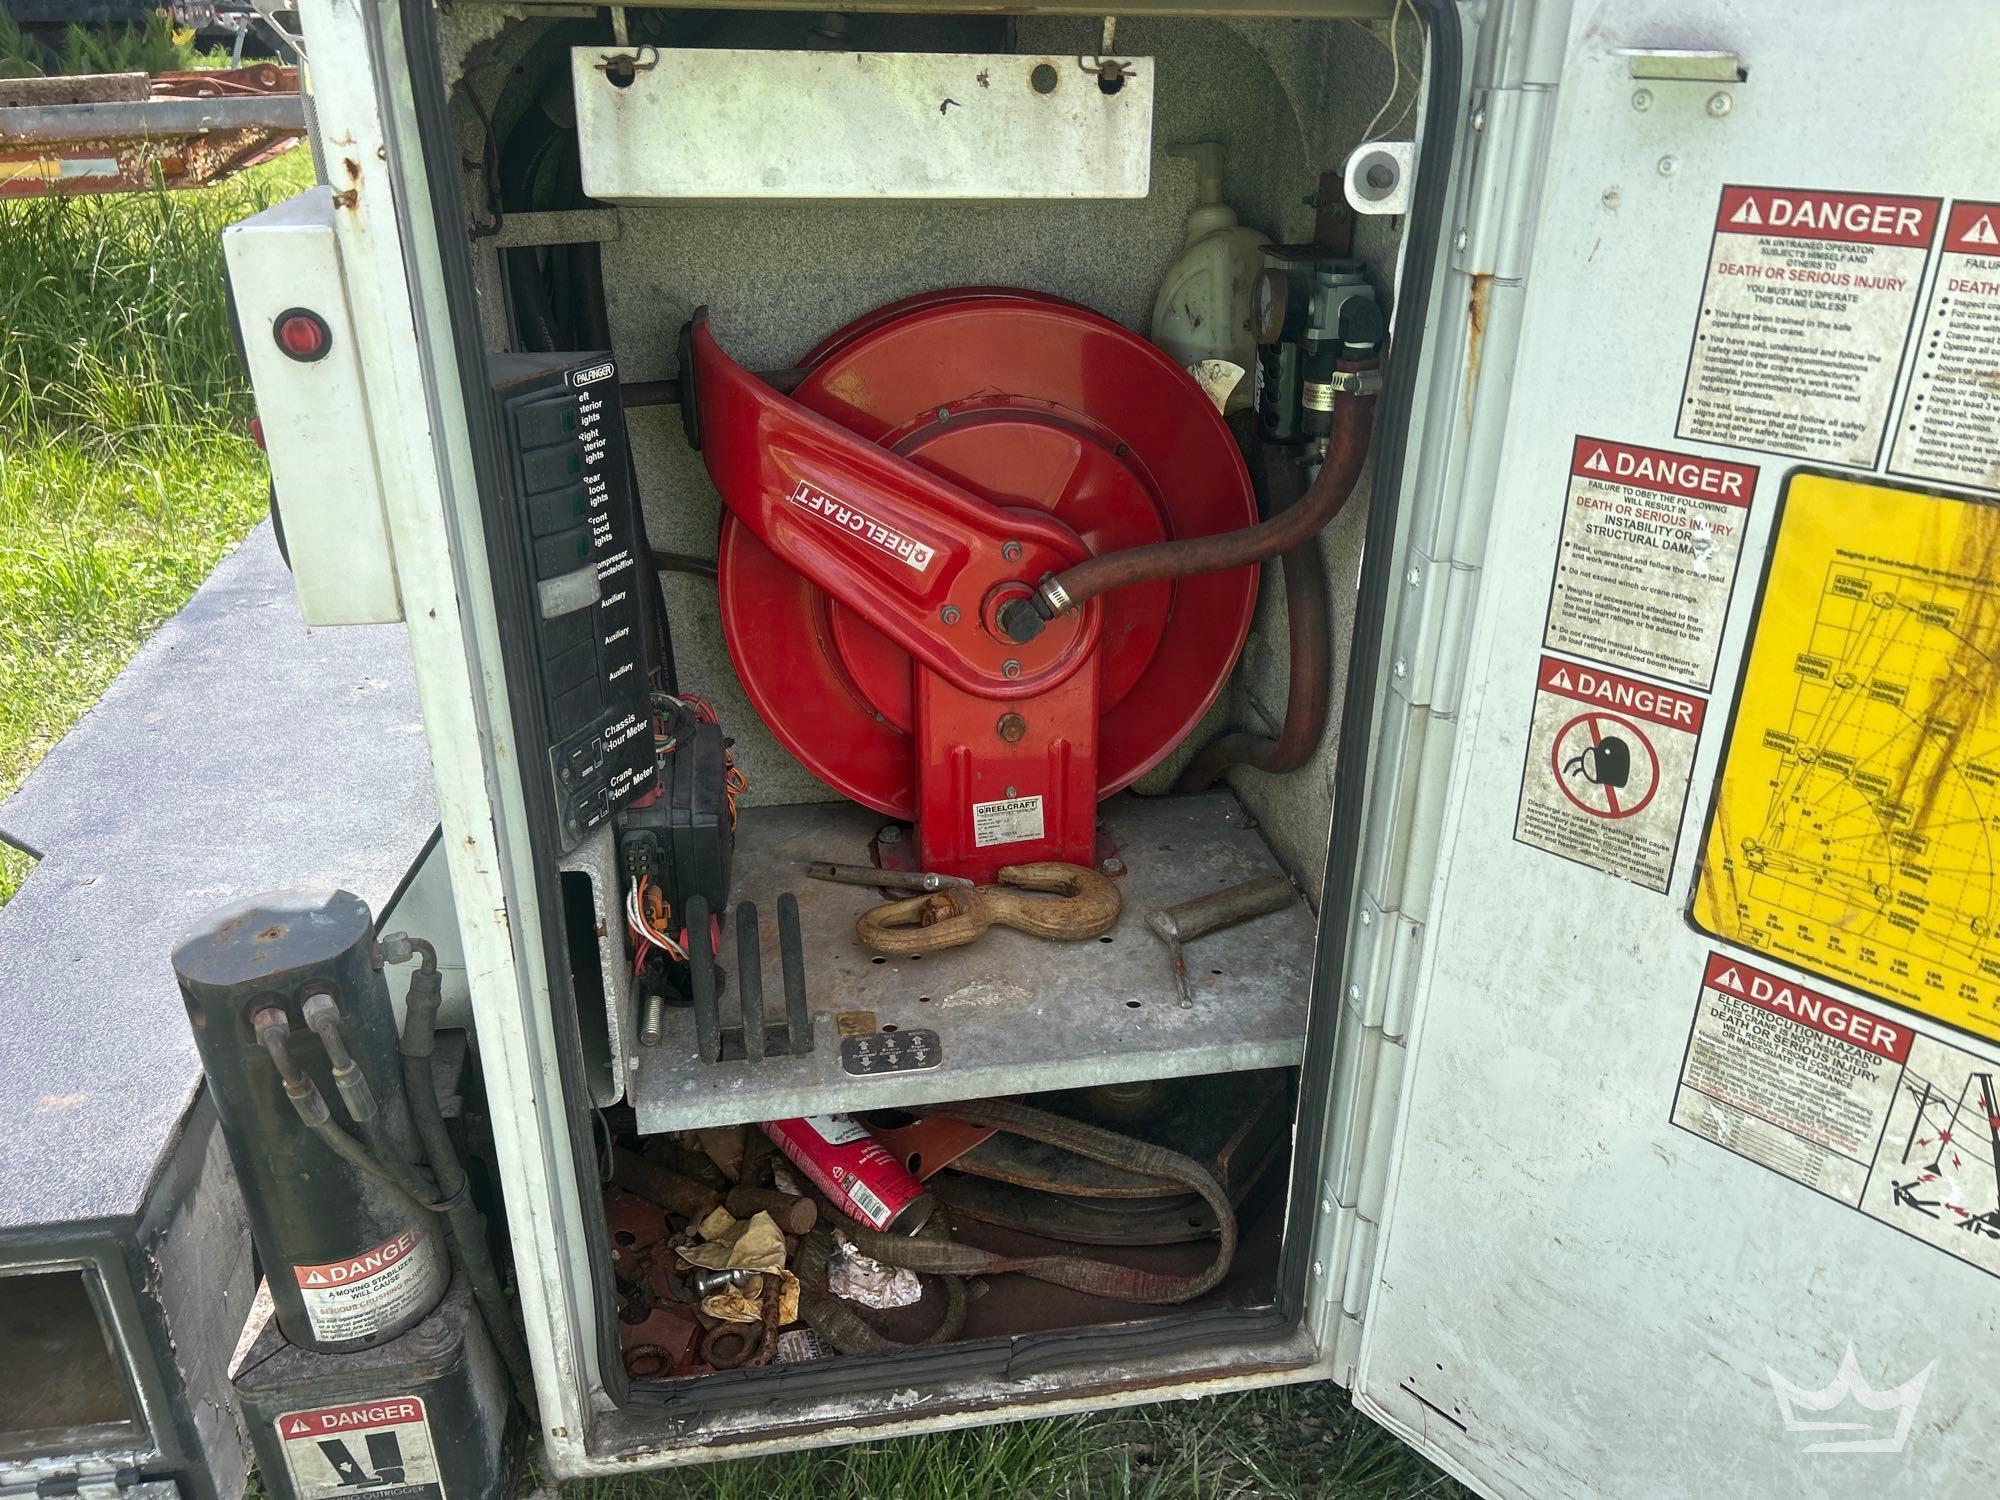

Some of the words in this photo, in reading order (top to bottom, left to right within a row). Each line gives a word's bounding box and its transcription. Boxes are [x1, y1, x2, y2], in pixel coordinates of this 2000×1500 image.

[1767, 198, 1926, 236] DANGER
[1758, 237, 1772, 246] AN
[1772, 239, 1823, 250] UNTRAINED
[1825, 243, 1875, 254] OPERATOR
[1760, 247, 1806, 258] SUBJECTS
[1807, 251, 1847, 262] HIMSELF
[1847, 255, 1868, 263] AND
[1786, 259, 1823, 269] OTHERS
[1824, 262, 1837, 270] TO
[1717, 262, 1762, 278] DEATH
[1764, 267, 1785, 280] OR
[1788, 269, 1851, 286] SERIOUS
[1853, 275, 1906, 291] INJURY
[1947, 278, 2000, 295] DEATH
[1746, 284, 1765, 293] YOU
[1766, 286, 1792, 296] MUST
[1793, 289, 1813, 298] NOT
[1814, 291, 1859, 302] OPERATE
[1754, 294, 1774, 304] THIS
[1774, 297, 1808, 307] CRANE
[1809, 300, 1847, 311] UNLESS
[576, 365, 611, 384] PALFINGER
[578, 391, 590, 402] eft
[581, 413, 600, 426] ights
[586, 451, 604, 464] ights
[1614, 452, 1744, 497] DANGER
[589, 482, 606, 494] lood
[1588, 480, 1620, 492] FAILURE
[1622, 487, 1634, 495] TO
[1635, 489, 1657, 500] OBEY
[1659, 494, 1675, 503] THE
[1676, 497, 1727, 513] FOLLOWING
[590, 493, 609, 507] ights
[1623, 496, 1643, 506] WILL
[1644, 500, 1676, 512] RESULT
[1677, 506, 1686, 514] IN
[1576, 496, 1612, 511] DEATH
[1615, 504, 1632, 515] OR
[1634, 508, 1686, 526] SERIOUS
[594, 522, 610, 535] lood
[796, 488, 914, 557] REELCRAFT
[1604, 515, 1672, 536] INSTABILITY
[1674, 529, 1692, 541] OR
[595, 533, 612, 547] ights
[1585, 524, 1659, 547] STRUCTURAL
[597, 551, 628, 570] ompressor
[1571, 551, 1584, 560] and
[1585, 554, 1602, 564] work
[1603, 558, 1619, 567] area
[1572, 543, 1592, 553] Read,
[1593, 547, 1632, 562] understand
[1633, 557, 1647, 566] and
[1648, 560, 1671, 571] follow
[1671, 565, 1684, 574] the
[1708, 573, 1725, 583] load
[1568, 567, 1578, 575] Do
[1579, 570, 1591, 578] not
[1592, 573, 1616, 584] exceed
[1617, 579, 1639, 590] winch
[1640, 584, 1648, 592] or
[1649, 586, 1670, 597] crane
[1671, 591, 1699, 604] ratings.
[601, 590, 626, 608] Auxiliary
[605, 626, 630, 645] Auxiliary
[1558, 634, 1567, 642] jib
[1567, 637, 1582, 646] load
[1583, 641, 1607, 653] ratings
[1608, 647, 1615, 655] at
[1616, 650, 1645, 663] reduced
[1646, 657, 1666, 669] boom
[1667, 663, 1697, 677] lengths.
[609, 662, 633, 681] Auxiliary
[1577, 673, 1694, 724] DANGER
[605, 714, 635, 738] Chassis
[626, 719, 647, 740] Meter
[610, 766, 632, 787] Crane
[633, 766, 653, 787] Meter
[986, 801, 1036, 812] REELCRAFT
[1750, 975, 1899, 1053] DANGER
[1717, 992, 1824, 1043] ELECTROCUTION
[1826, 1037, 1883, 1068] HAZARD
[1722, 1004, 1742, 1017] THIS
[1743, 1012, 1777, 1032] CRANE
[1779, 1027, 1789, 1036] IS
[1790, 1032, 1811, 1046] NOT
[1812, 1041, 1868, 1070] INSULATED
[1710, 1007, 1749, 1030] DEATH
[1751, 1024, 1770, 1039] OR
[1772, 1033, 1829, 1064] SERIOUS
[1831, 1058, 1879, 1085] INJURY
[1722, 1022, 1743, 1035] WILL
[1745, 1031, 1779, 1051] RESULT
[1781, 1046, 1808, 1063] FROM
[1809, 1058, 1854, 1083] CONTACT
[1721, 1029, 1735, 1040] OR
[1737, 1035, 1793, 1065] INADEQUATE
[1795, 1060, 1853, 1090] CLEARANCE
[337, 1283, 370, 1296] MOVING
[372, 1256, 413, 1285] STABILIZER
[351, 1291, 373, 1300] WILL
[374, 1274, 400, 1292] CAUSE
[320, 1303, 358, 1314] SERIOUS
[359, 1283, 402, 1308] CRUSHING
[321, 1404, 415, 1428] DANGER
[362, 1486, 424, 1499] OUTRIGGER
